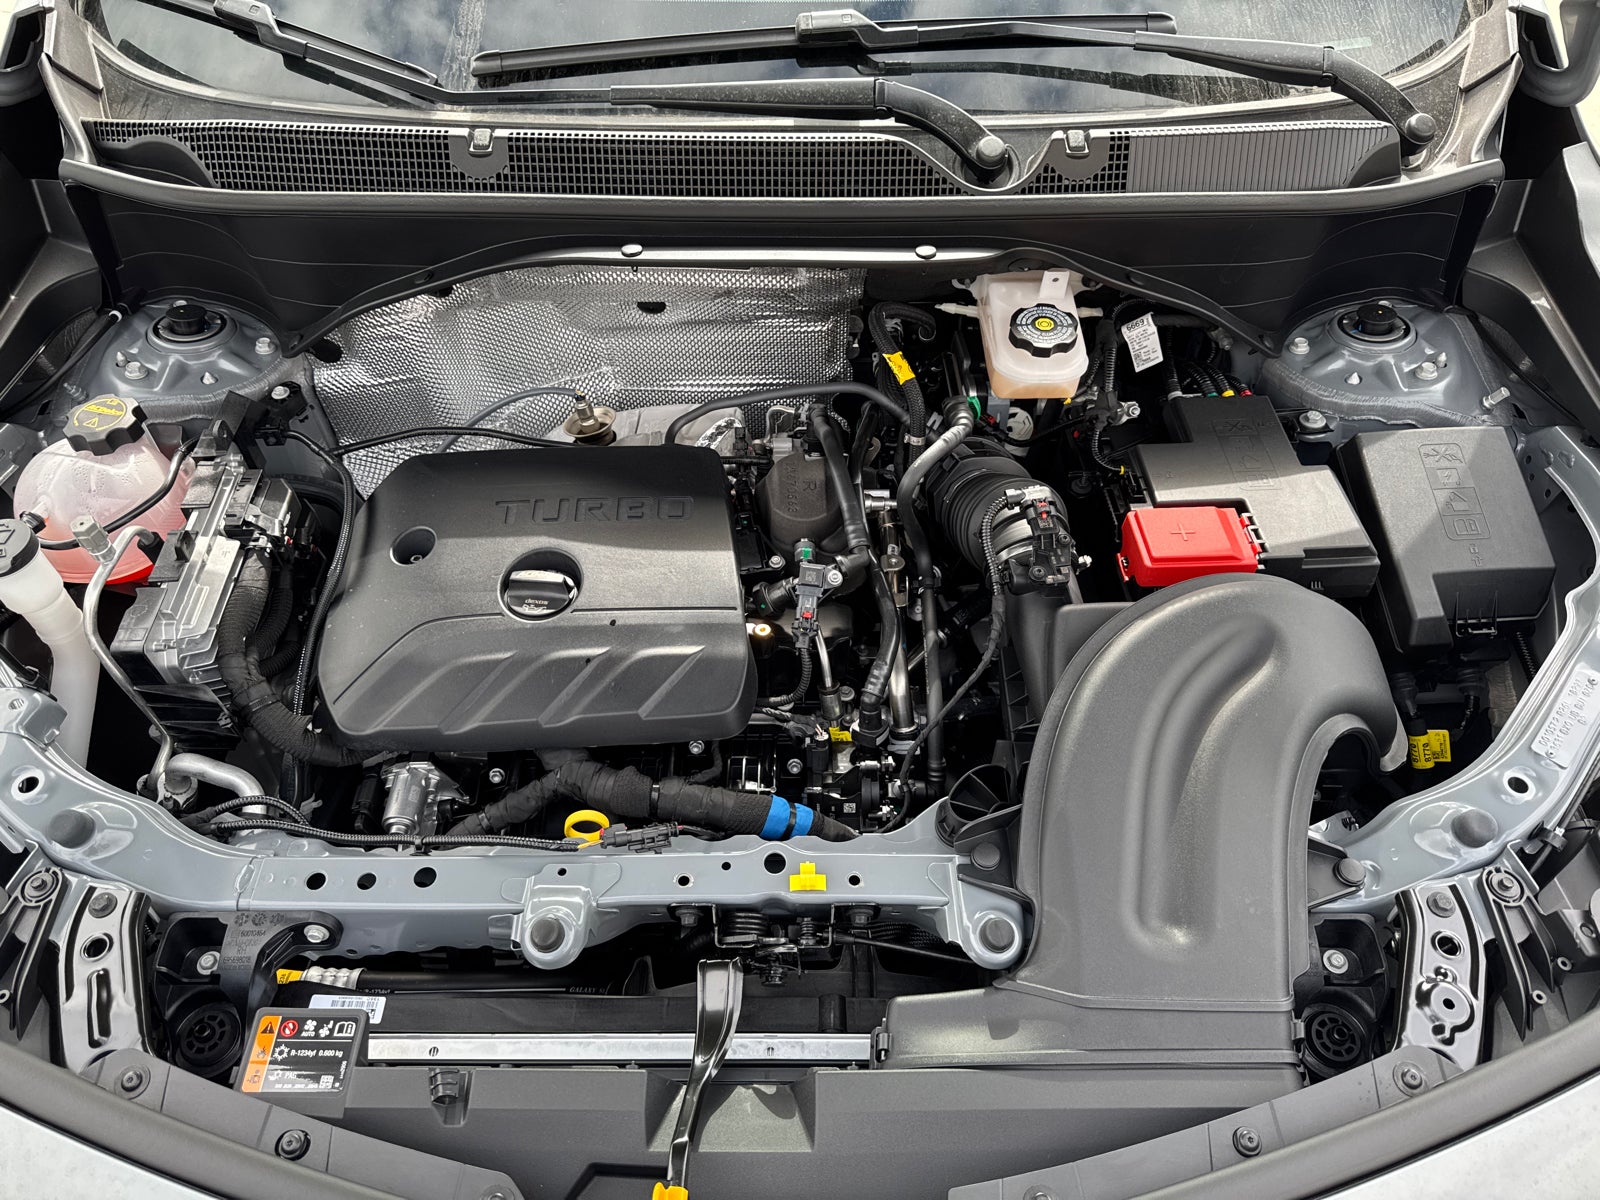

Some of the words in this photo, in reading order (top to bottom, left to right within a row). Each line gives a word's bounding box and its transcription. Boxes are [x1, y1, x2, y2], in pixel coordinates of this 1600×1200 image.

[1126, 318, 1145, 332] 6669
[495, 495, 694, 524] TURBO
[1411, 742, 1420, 763] 8770
[1424, 742, 1432, 763] 8770
[290, 1049, 317, 1057] R-1234yf
